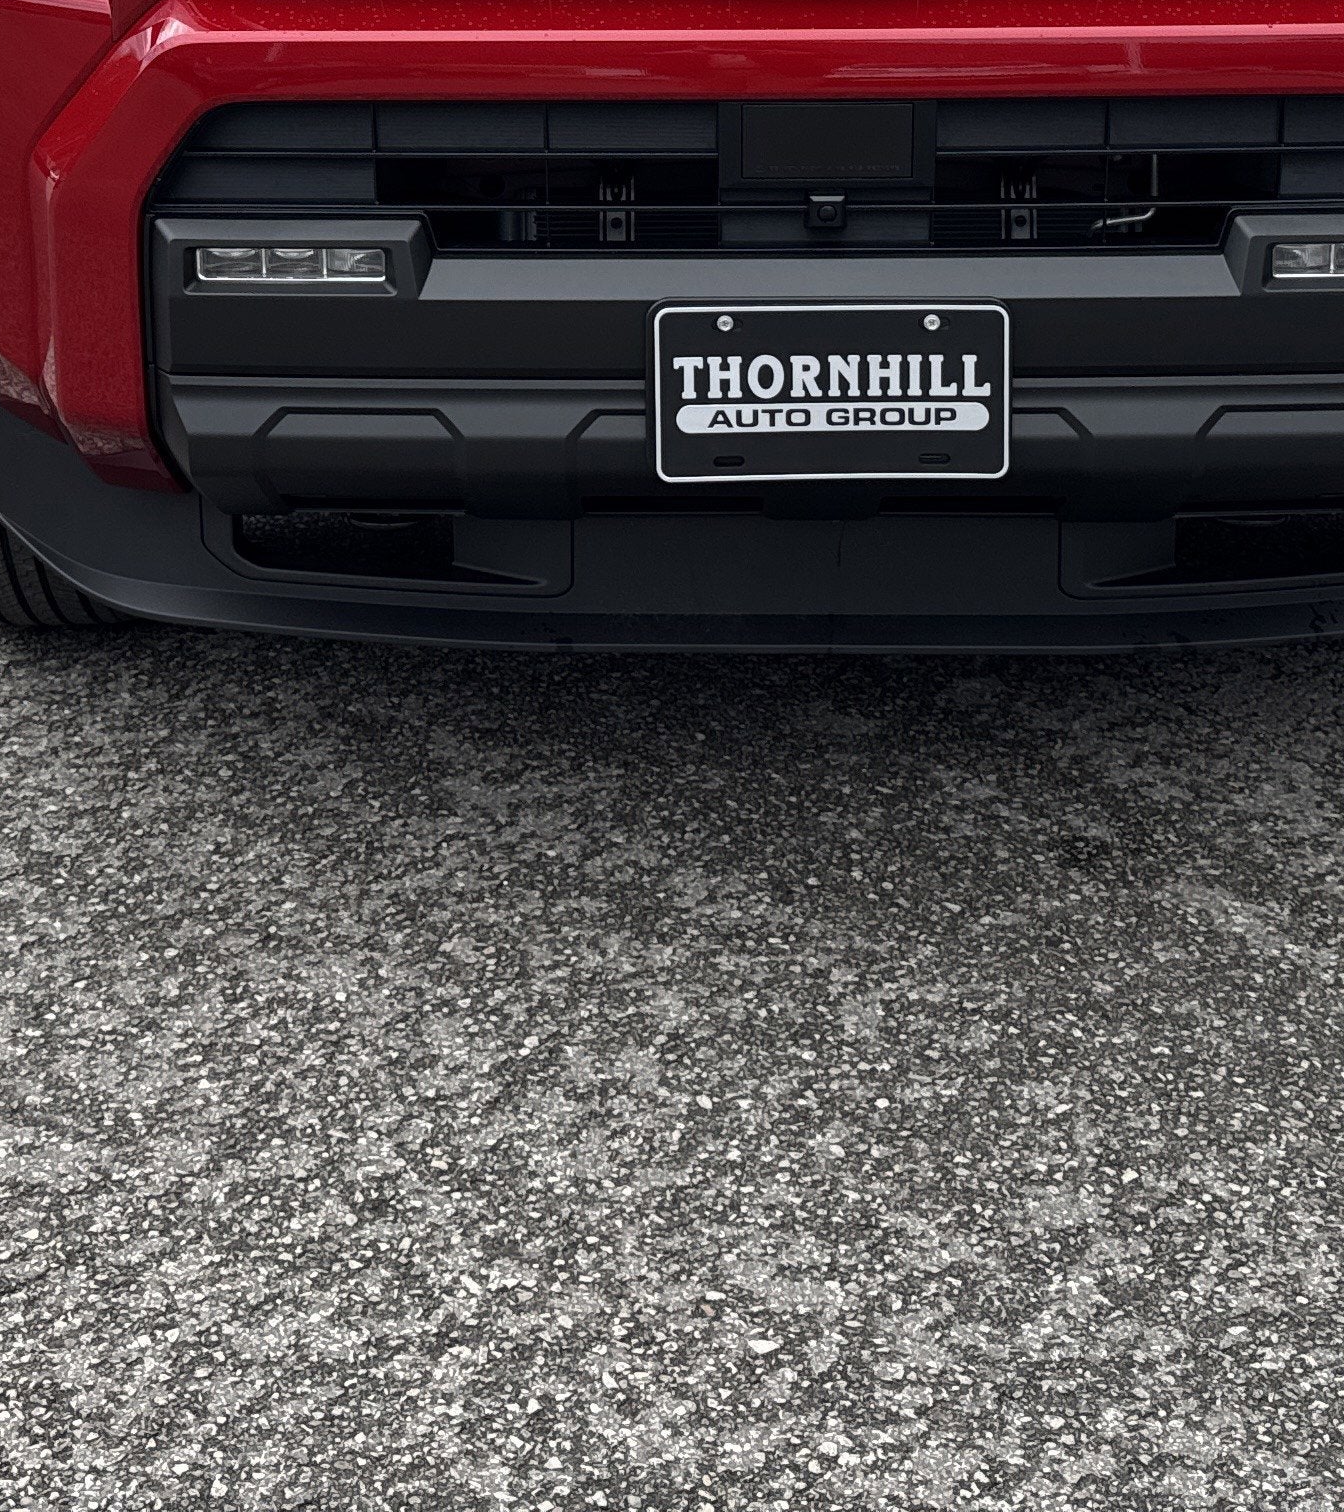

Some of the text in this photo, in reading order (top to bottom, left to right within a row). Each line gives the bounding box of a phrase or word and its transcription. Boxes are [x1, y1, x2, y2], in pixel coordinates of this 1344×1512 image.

[673, 354, 991, 399] THORNHILL
[707, 407, 957, 428] AUTO GROUP
